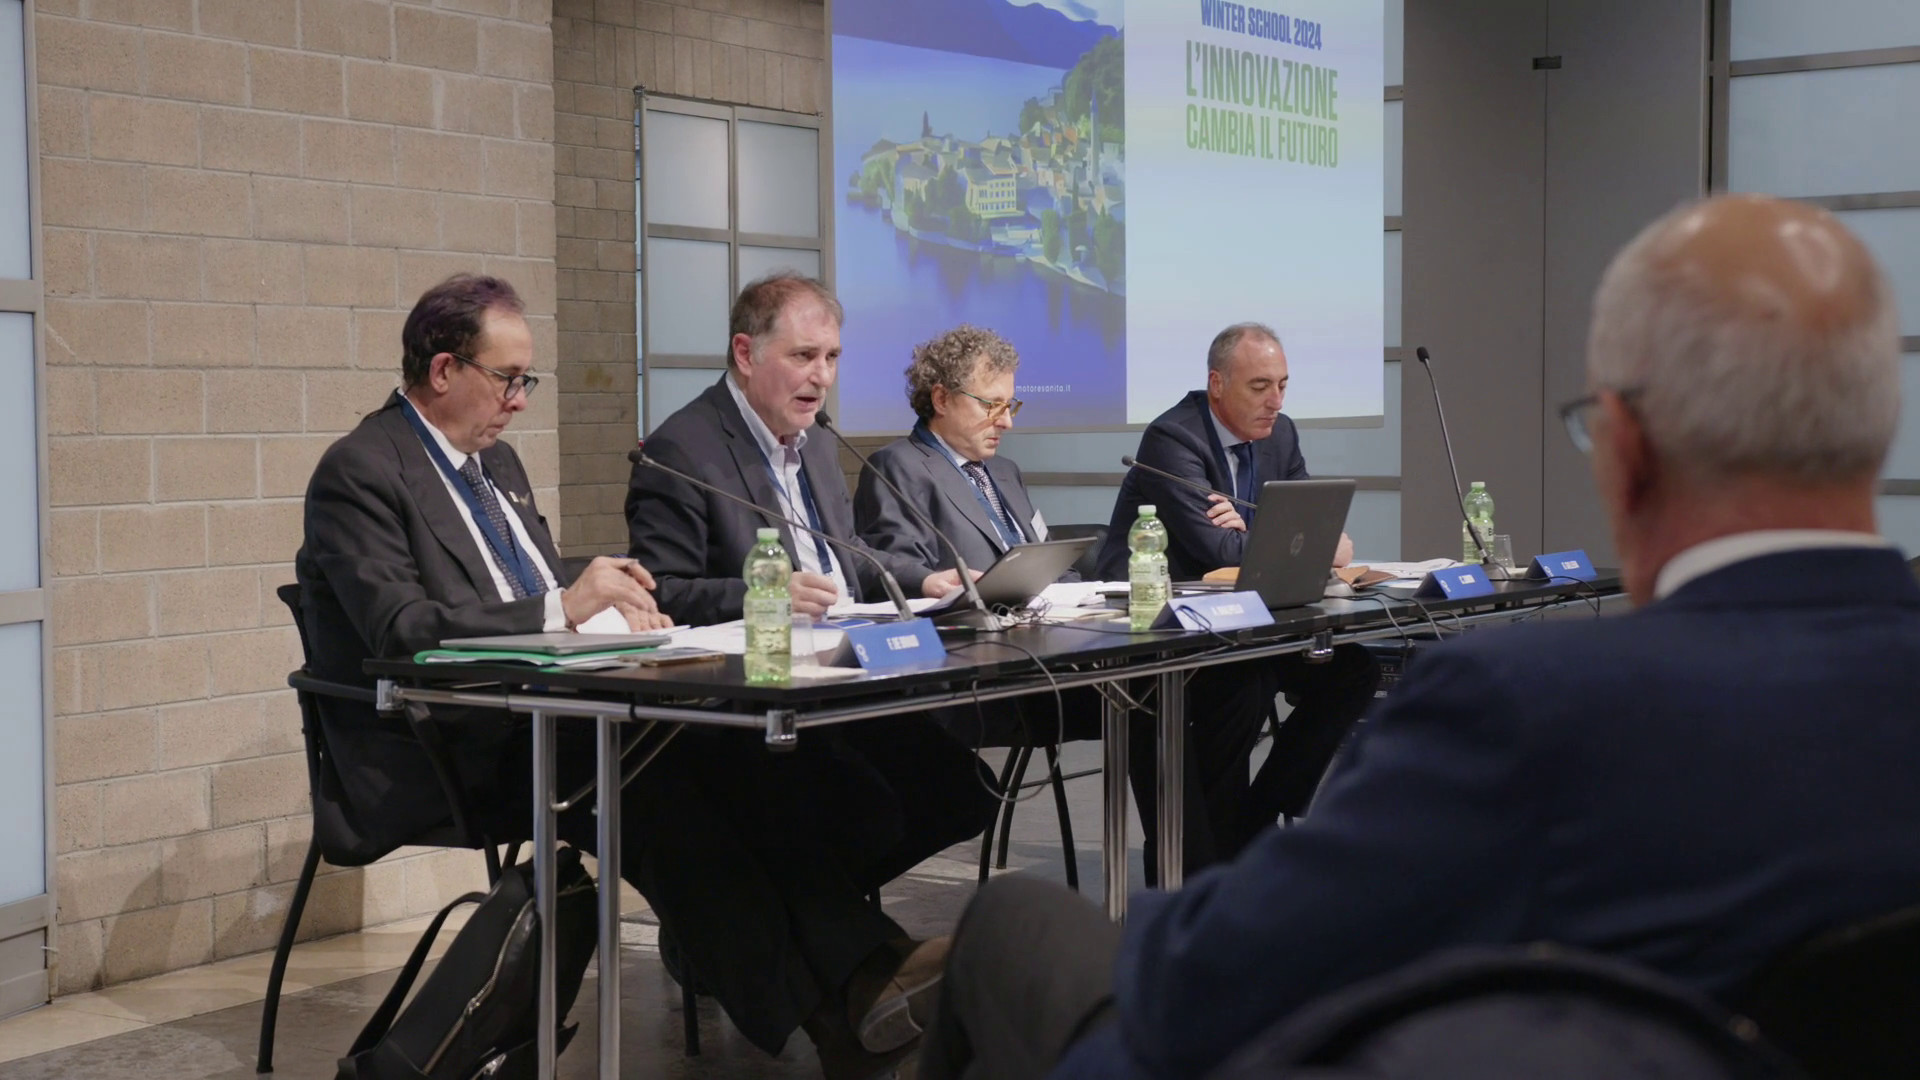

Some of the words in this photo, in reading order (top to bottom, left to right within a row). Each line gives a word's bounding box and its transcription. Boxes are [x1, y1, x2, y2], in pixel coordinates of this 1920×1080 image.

[1200, 0, 1245, 34] WINTER
[1248, 7, 1292, 44] SCHOOL
[1294, 18, 1322, 50] 2024
[1186, 40, 1338, 121] L'INNOVAZIONE
[1186, 103, 1255, 157] CAMBIA
[1260, 115, 1274, 160] IL
[1278, 118, 1338, 168] FUTURO
